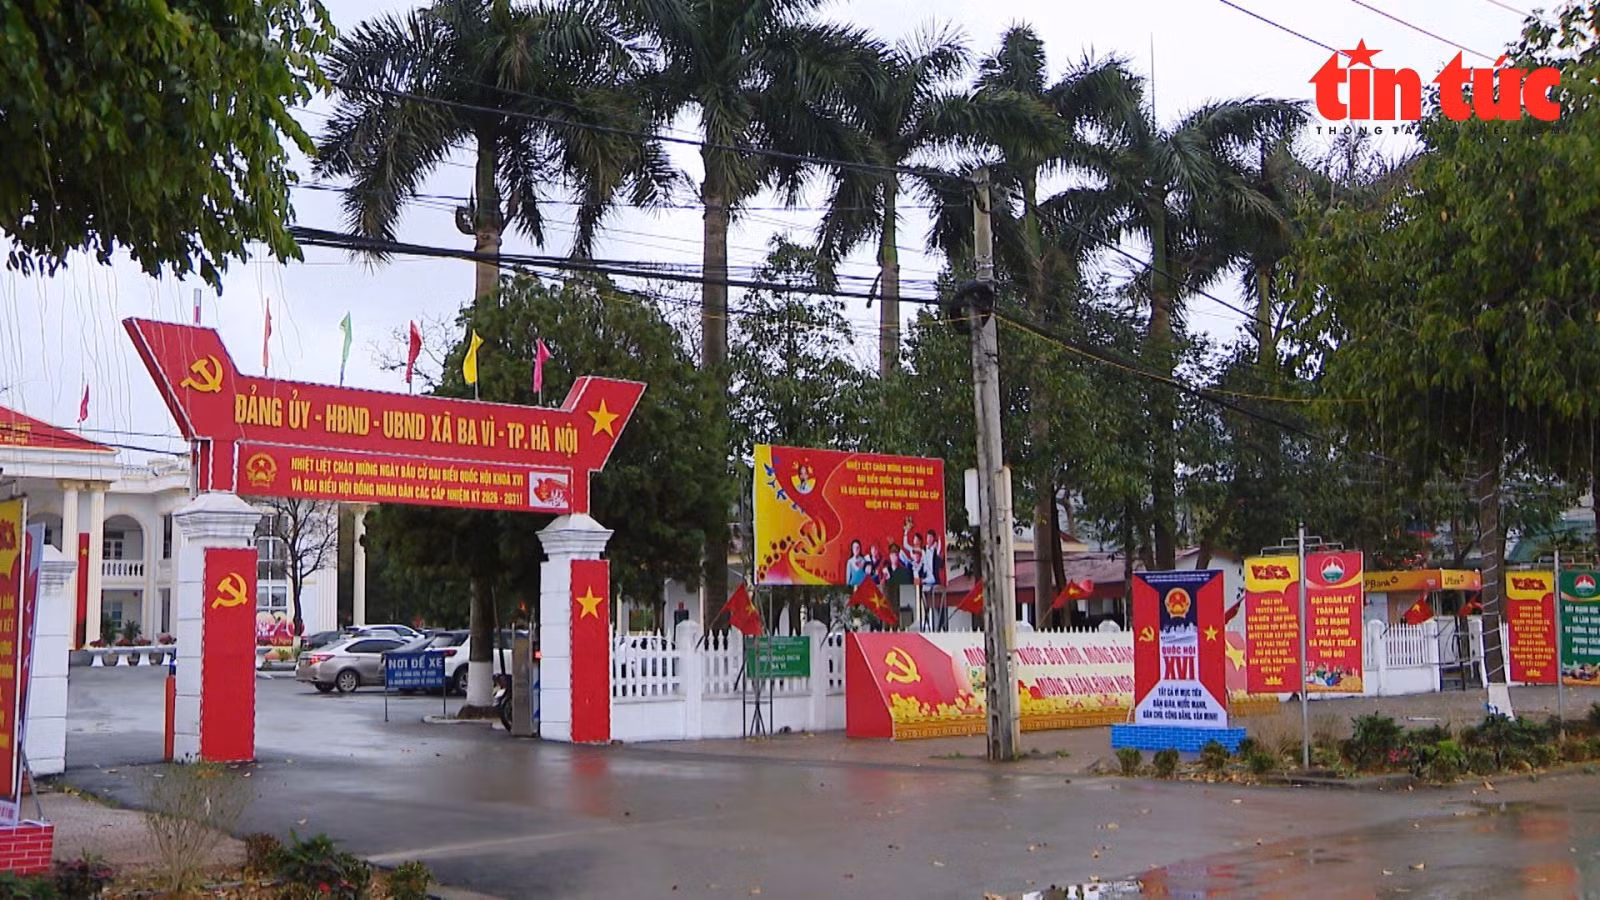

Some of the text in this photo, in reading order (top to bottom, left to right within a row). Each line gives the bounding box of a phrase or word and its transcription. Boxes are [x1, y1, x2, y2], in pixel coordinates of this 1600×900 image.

[234, 385, 283, 427] ĐẢNG
[288, 389, 311, 430] ỦY
[325, 404, 370, 436] HĐND
[383, 410, 426, 441] UBND
[430, 411, 452, 443] XÃ
[457, 417, 478, 446] BA
[481, 415, 495, 447] VÌ
[507, 422, 529, 449] TP.
[531, 420, 550, 452] HÀ
[554, 422, 578, 458] NỘI
[291, 456, 314, 474] NHIỆT
[315, 457, 331, 475] LIỆT
[333, 459, 353, 474] CHÀO
[355, 460, 378, 476] MỪNG
[379, 462, 400, 478] NGÀY
[401, 462, 416, 478] BẦU
[417, 462, 427, 480] CỬ
[428, 467, 441, 484] ĐẠI
[442, 464, 459, 482] BIỂU
[460, 467, 478, 483] QUỐC
[479, 469, 491, 486] HỘI
[512, 474, 523, 486] XVI
[291, 475, 302, 492] VÀ
[303, 478, 317, 495] ĐẠI
[320, 475, 337, 493] BIỂU
[338, 478, 352, 496] HỘI
[353, 478, 374, 495] ĐỒNG
[376, 481, 397, 497] NHÂN
[398, 483, 413, 498] DÂN
[415, 484, 430, 499] CÁC
[431, 484, 445, 500] CẤP
[447, 487, 470, 504] NHIỆM
[471, 488, 480, 503] KỲ
[1163, 656, 1195, 680] XVI
